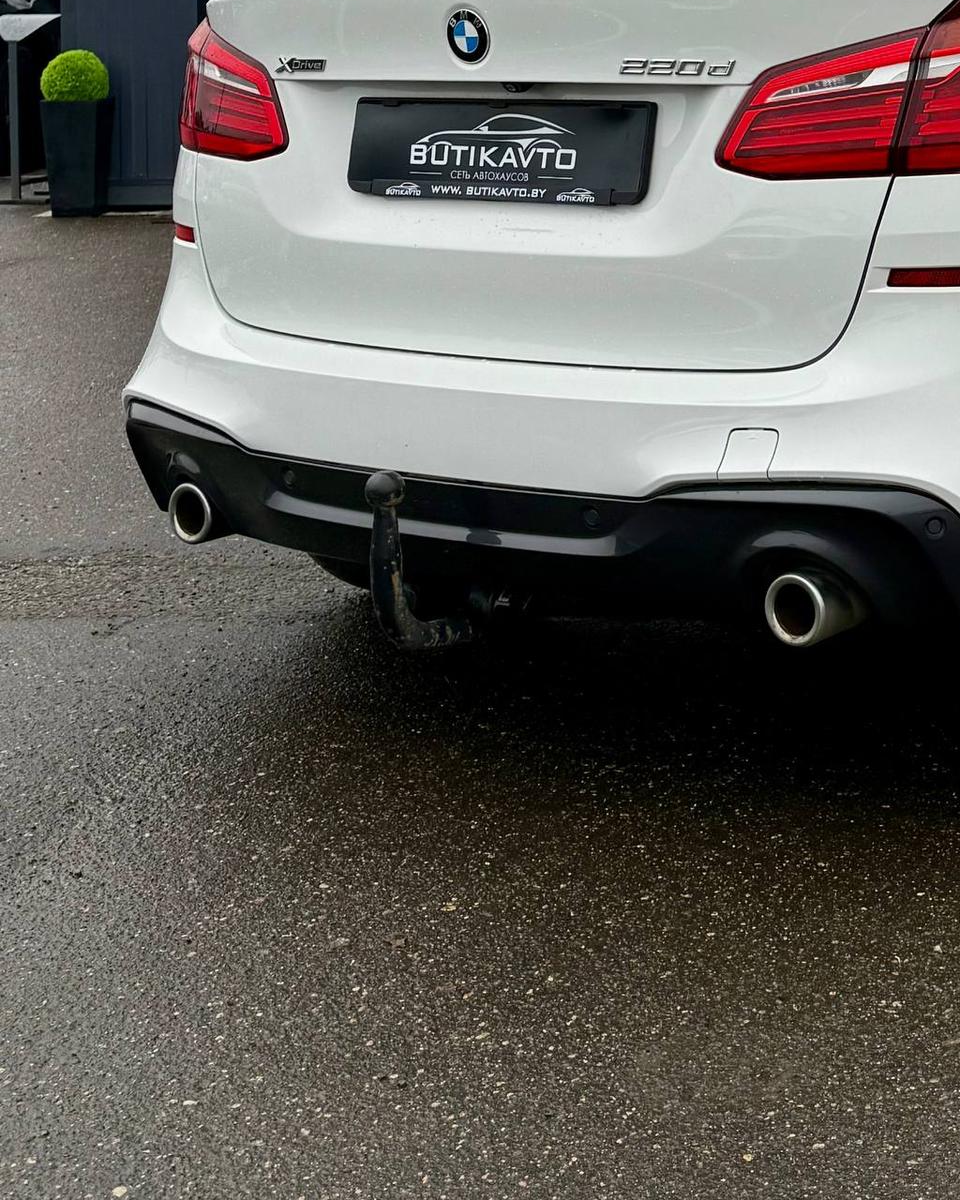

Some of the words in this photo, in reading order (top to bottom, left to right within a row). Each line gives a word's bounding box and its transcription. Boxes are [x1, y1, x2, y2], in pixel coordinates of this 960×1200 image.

[409, 144, 577, 170] BUTIKAVTO
[450, 170, 471, 180] СЕТЬ
[472, 171, 529, 182] АВТОХАУСОВ
[385, 187, 421, 196] BUTIKAVTO
[466, 186, 547, 198] BUTIKAVTO.BY
[556, 193, 595, 202] BUTIKAVTO
